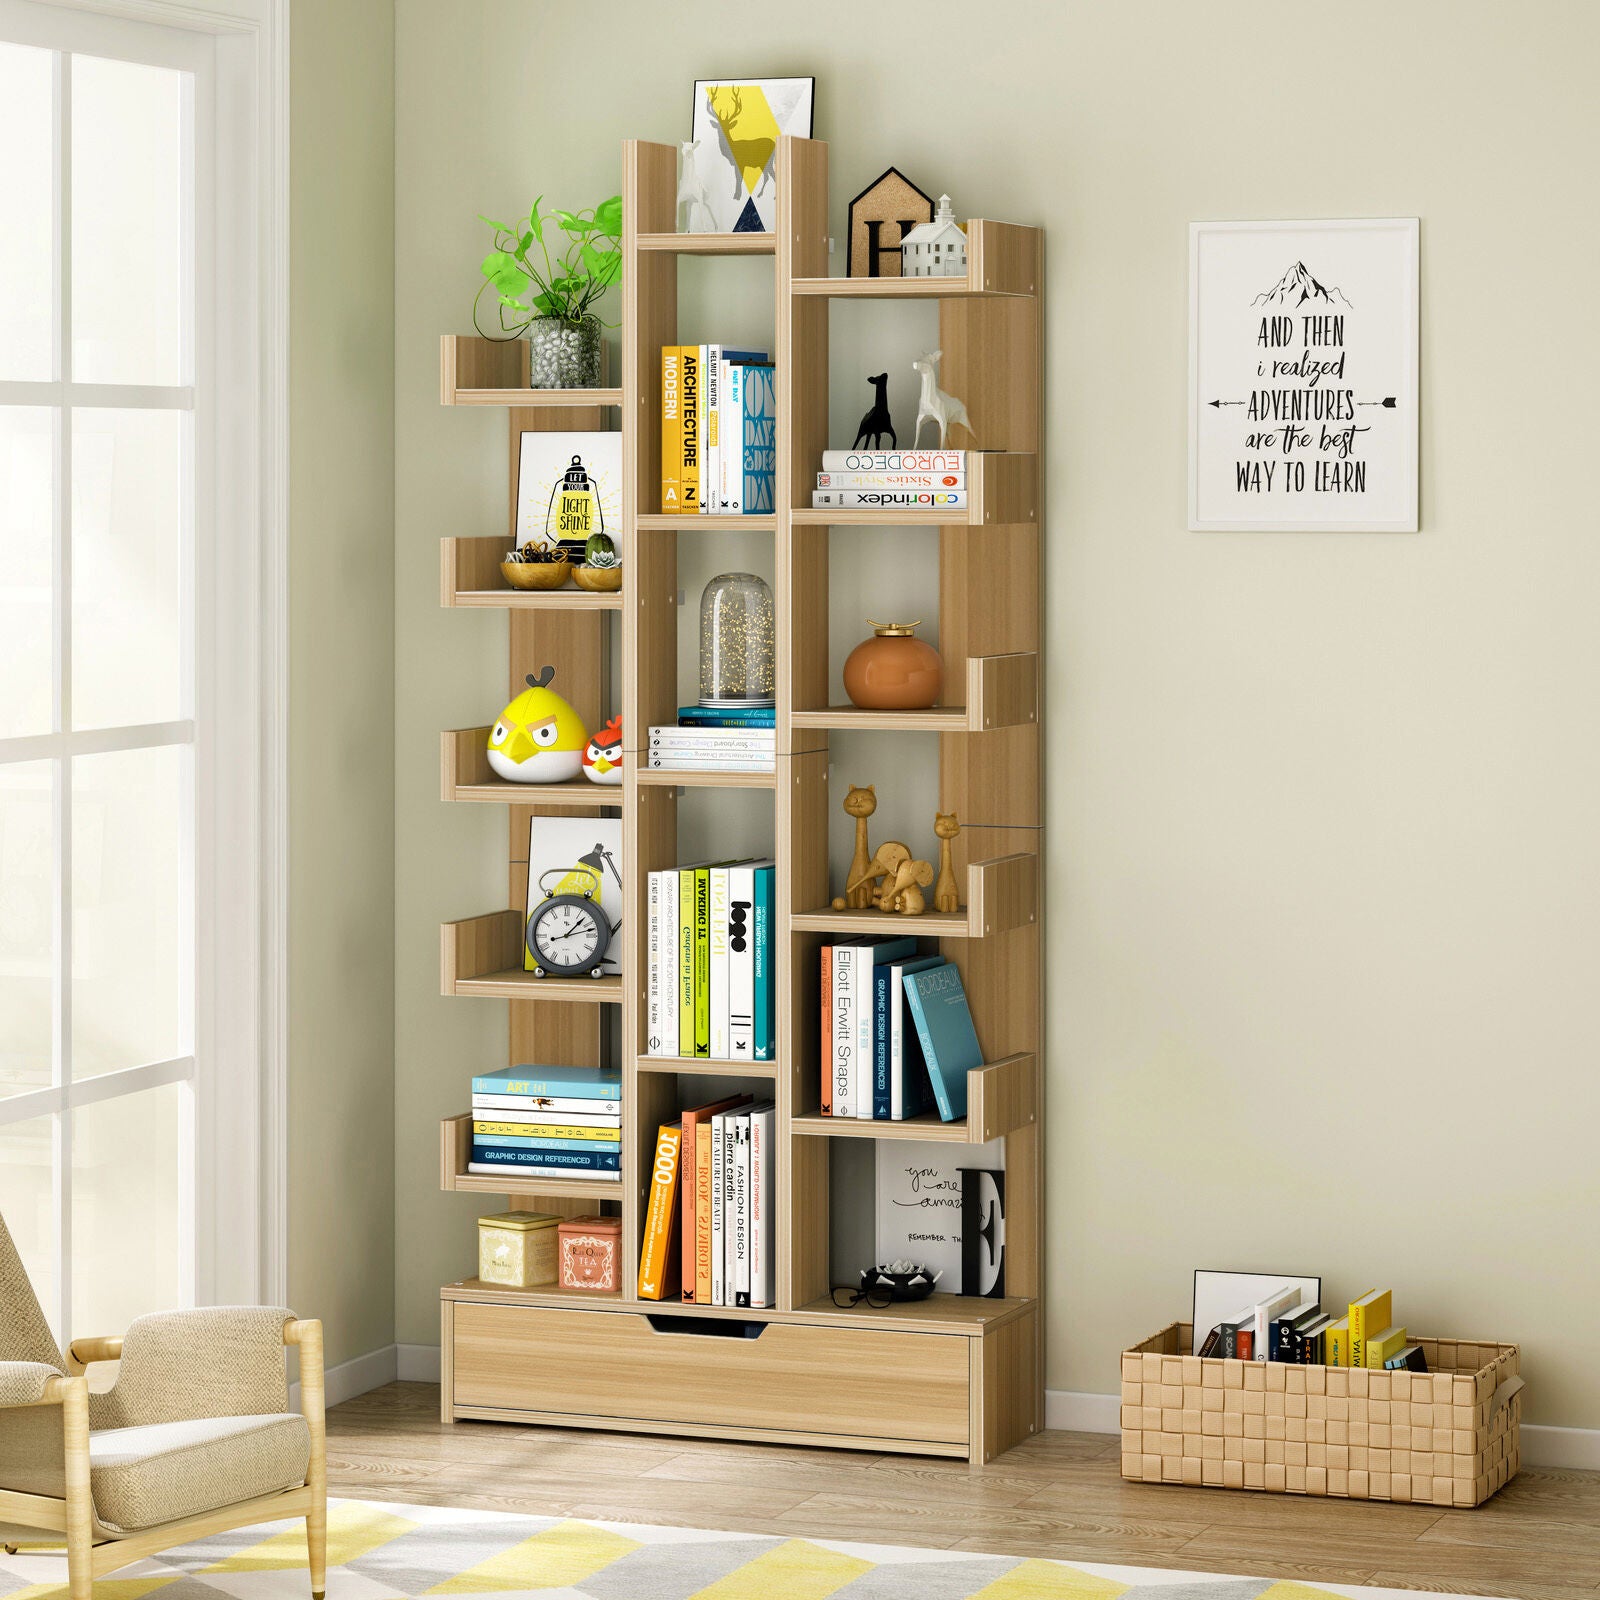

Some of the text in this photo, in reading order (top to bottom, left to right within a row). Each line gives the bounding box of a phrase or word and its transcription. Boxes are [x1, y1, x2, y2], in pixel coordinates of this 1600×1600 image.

[864, 220, 916, 277] H
[1258, 315, 1344, 347] AND THEN
[1258, 350, 1345, 387] i realized
[665, 356, 677, 419] MODERN
[684, 356, 696, 467] ARCHITECTURE
[1248, 390, 1354, 421] ADVENTURES
[1246, 424, 1372, 459] are the best
[846, 456, 960, 470] EURODECO
[570, 473, 583, 481] LET
[886, 476, 932, 486] Sixties
[1237, 461, 1366, 493] WAY TO LEARN
[666, 488, 677, 500] A
[858, 494, 958, 506] colorindex
[562, 497, 590, 516] LIGHT
[560, 514, 590, 534] SHINE
[714, 741, 749, 749] Storyboard
[836, 951, 851, 1097] Elliott Erwitt Snaps
[920, 1033, 936, 1072] BORDEAUX
[506, 1082, 530, 1093] ART
[485, 1152, 591, 1164] GRAPHIC DESIGN REFERENCED
[726, 1133, 736, 1201] pierre cardin
[714, 1183, 721, 1195] OF
[905, 1168, 938, 1192] you
[924, 1181, 962, 1192] are
[908, 1234, 946, 1242] REMEMBER
[956, 1168, 1005, 1299] E
[579, 1257, 597, 1266] TEA
